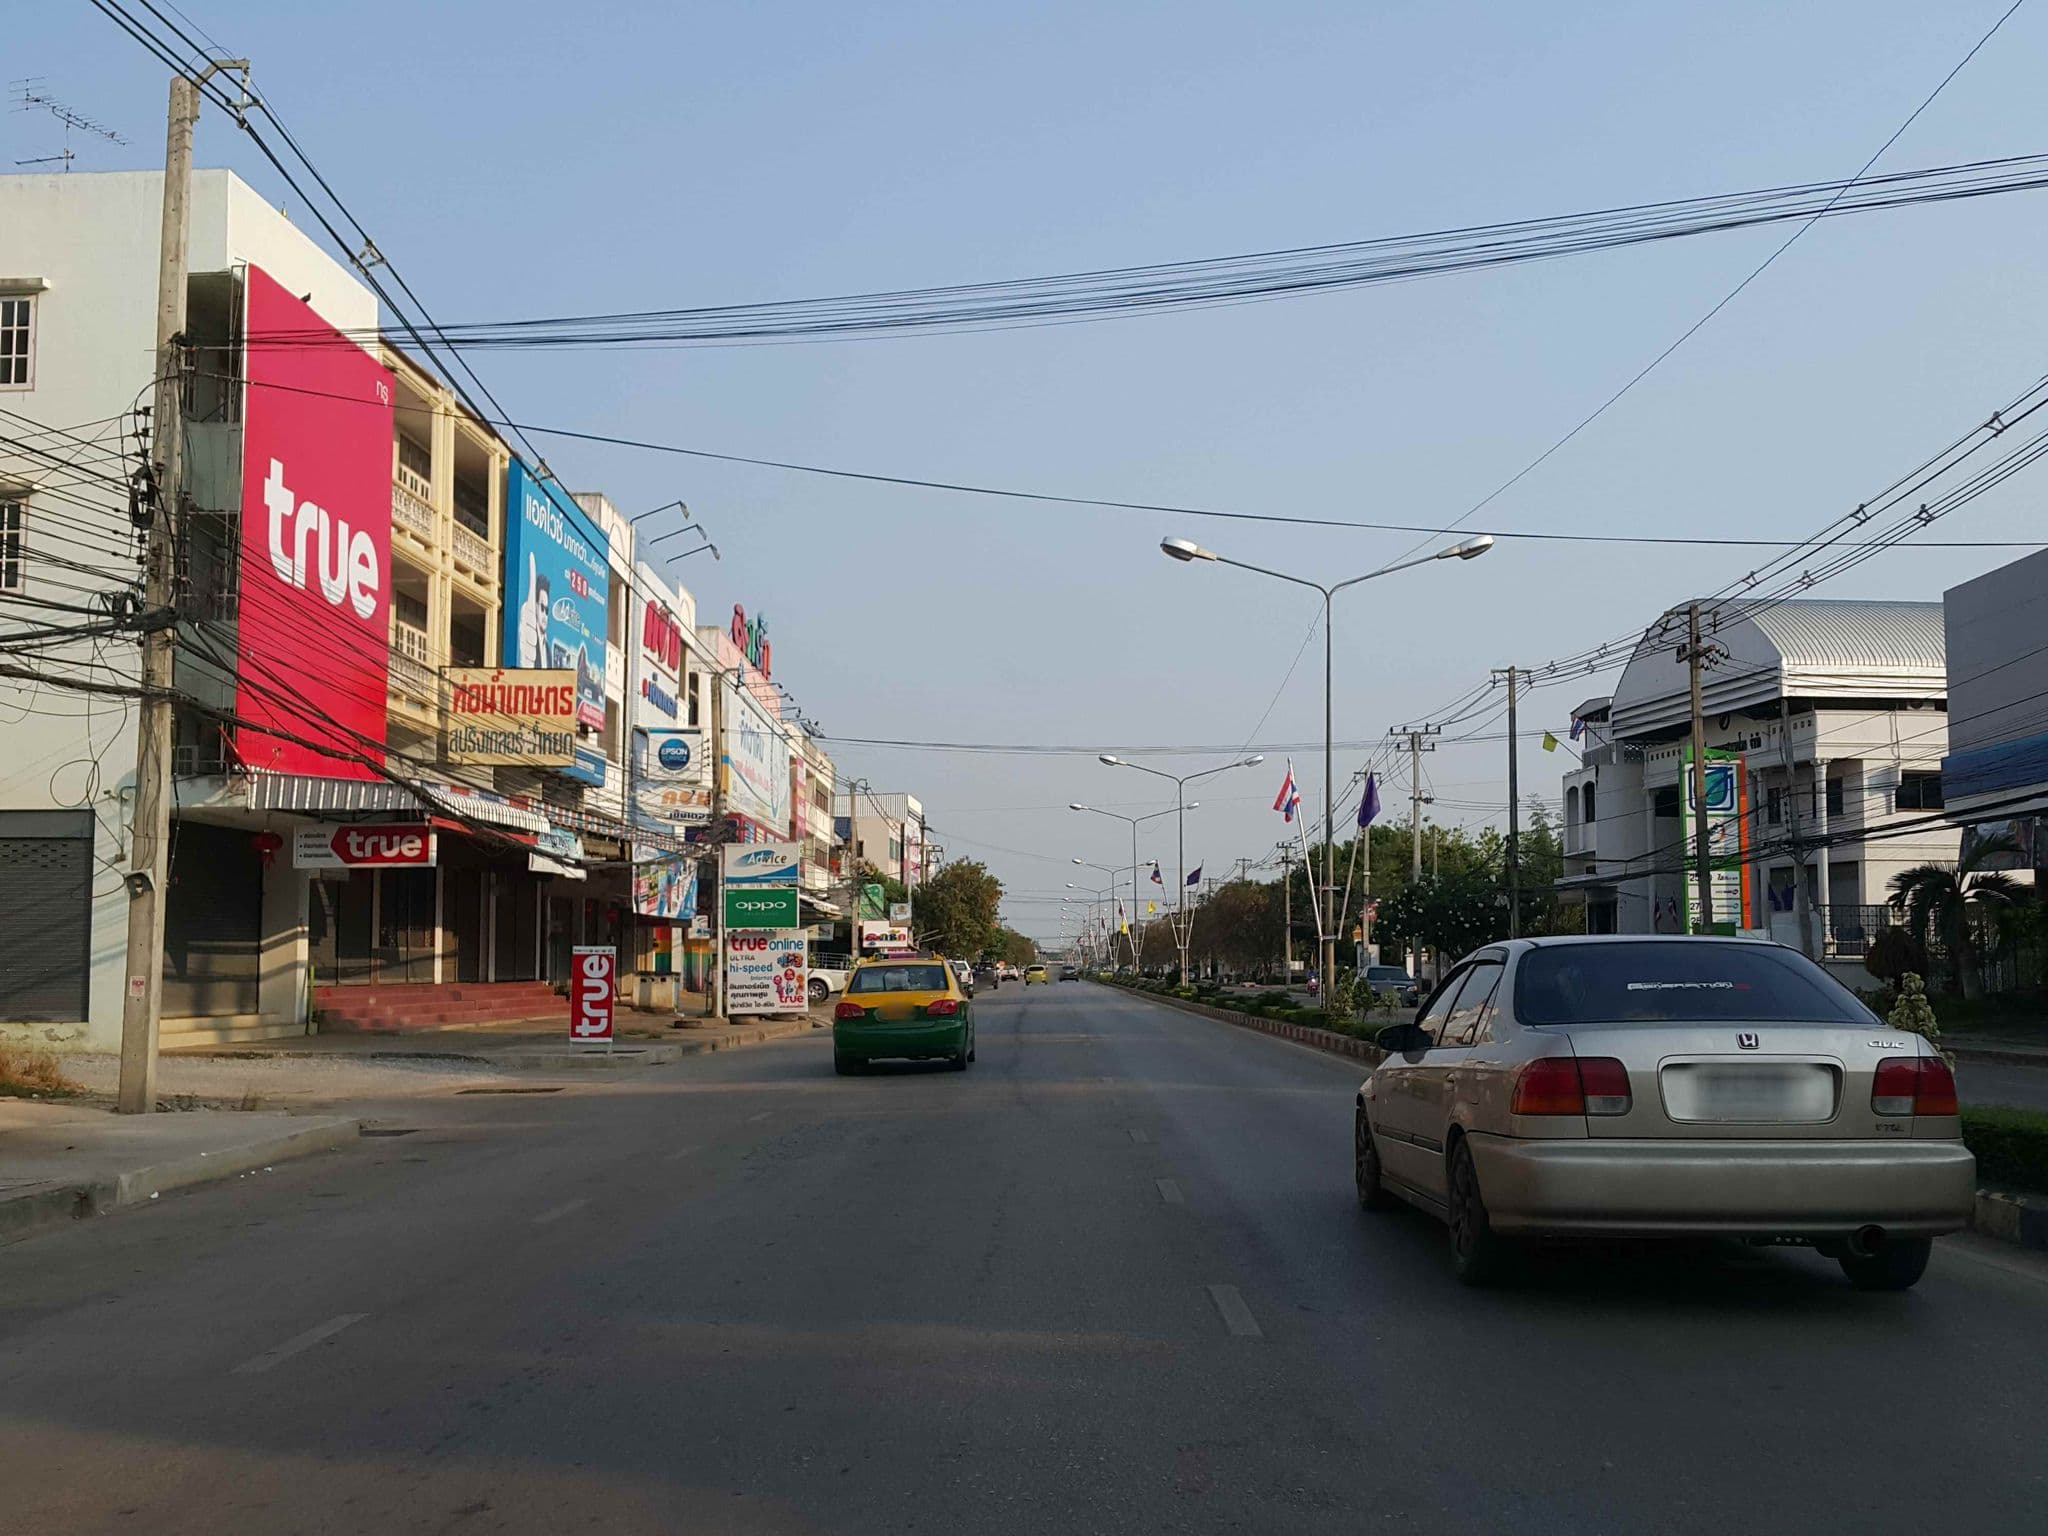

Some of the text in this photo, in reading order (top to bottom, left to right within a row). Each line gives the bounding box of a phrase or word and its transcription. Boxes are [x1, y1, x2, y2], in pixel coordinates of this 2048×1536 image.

[264, 457, 379, 620] true
[571, 571, 588, 597] 250
[453, 669, 574, 716] ท่อน้ำเกษตร
[661, 747, 688, 756] EPSON
[346, 831, 422, 858] true
[747, 851, 788, 864] Advice
[730, 935, 804, 951] true online
[729, 962, 773, 974] hi-speed
[575, 955, 610, 1037] true
[779, 994, 805, 1004] true
